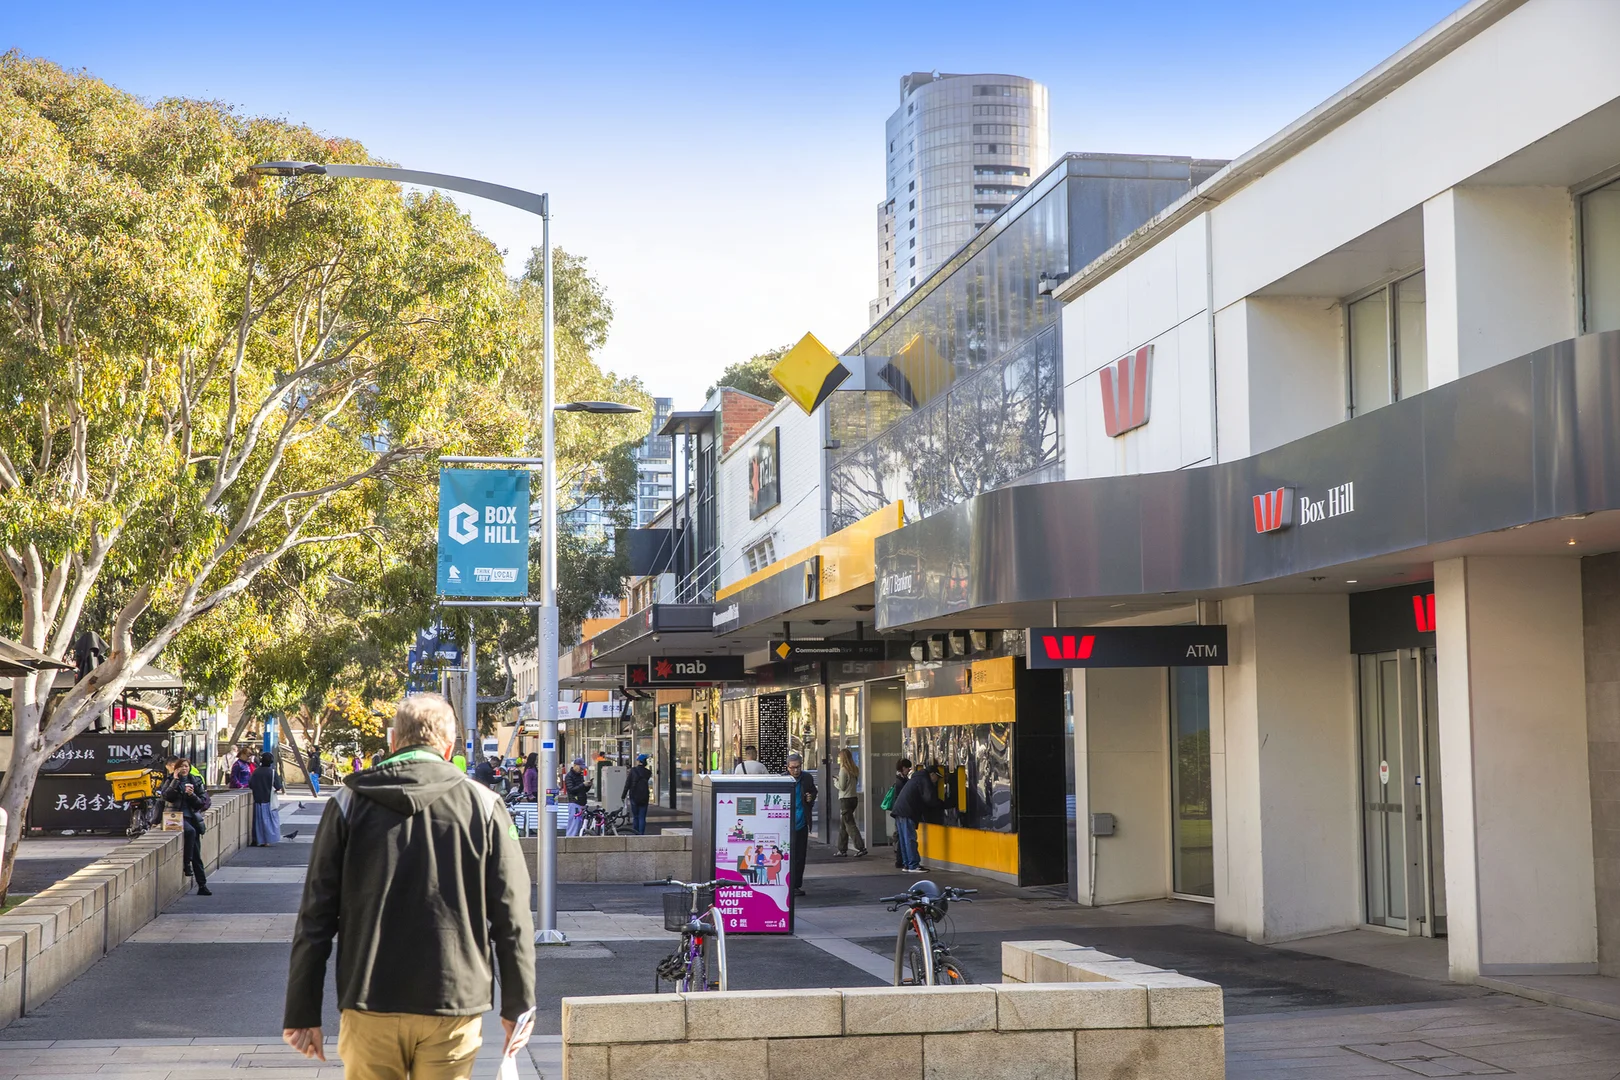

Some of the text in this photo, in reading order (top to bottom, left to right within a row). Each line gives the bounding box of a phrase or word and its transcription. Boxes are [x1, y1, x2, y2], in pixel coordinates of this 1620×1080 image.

[1300, 496, 1326, 526] Box
[1328, 481, 1355, 518] Hill
[485, 506, 517, 524] BOX
[484, 526, 520, 544] HILL
[494, 570, 513, 579] LOCAL
[894, 573, 912, 594] Banking
[1186, 644, 1218, 658] ATM
[676, 659, 707, 674] nab
[107, 744, 153, 757] TINA'S
[54, 794, 131, 811] 天府李米
[719, 890, 753, 898] WHERE
[719, 907, 744, 915] MEET
